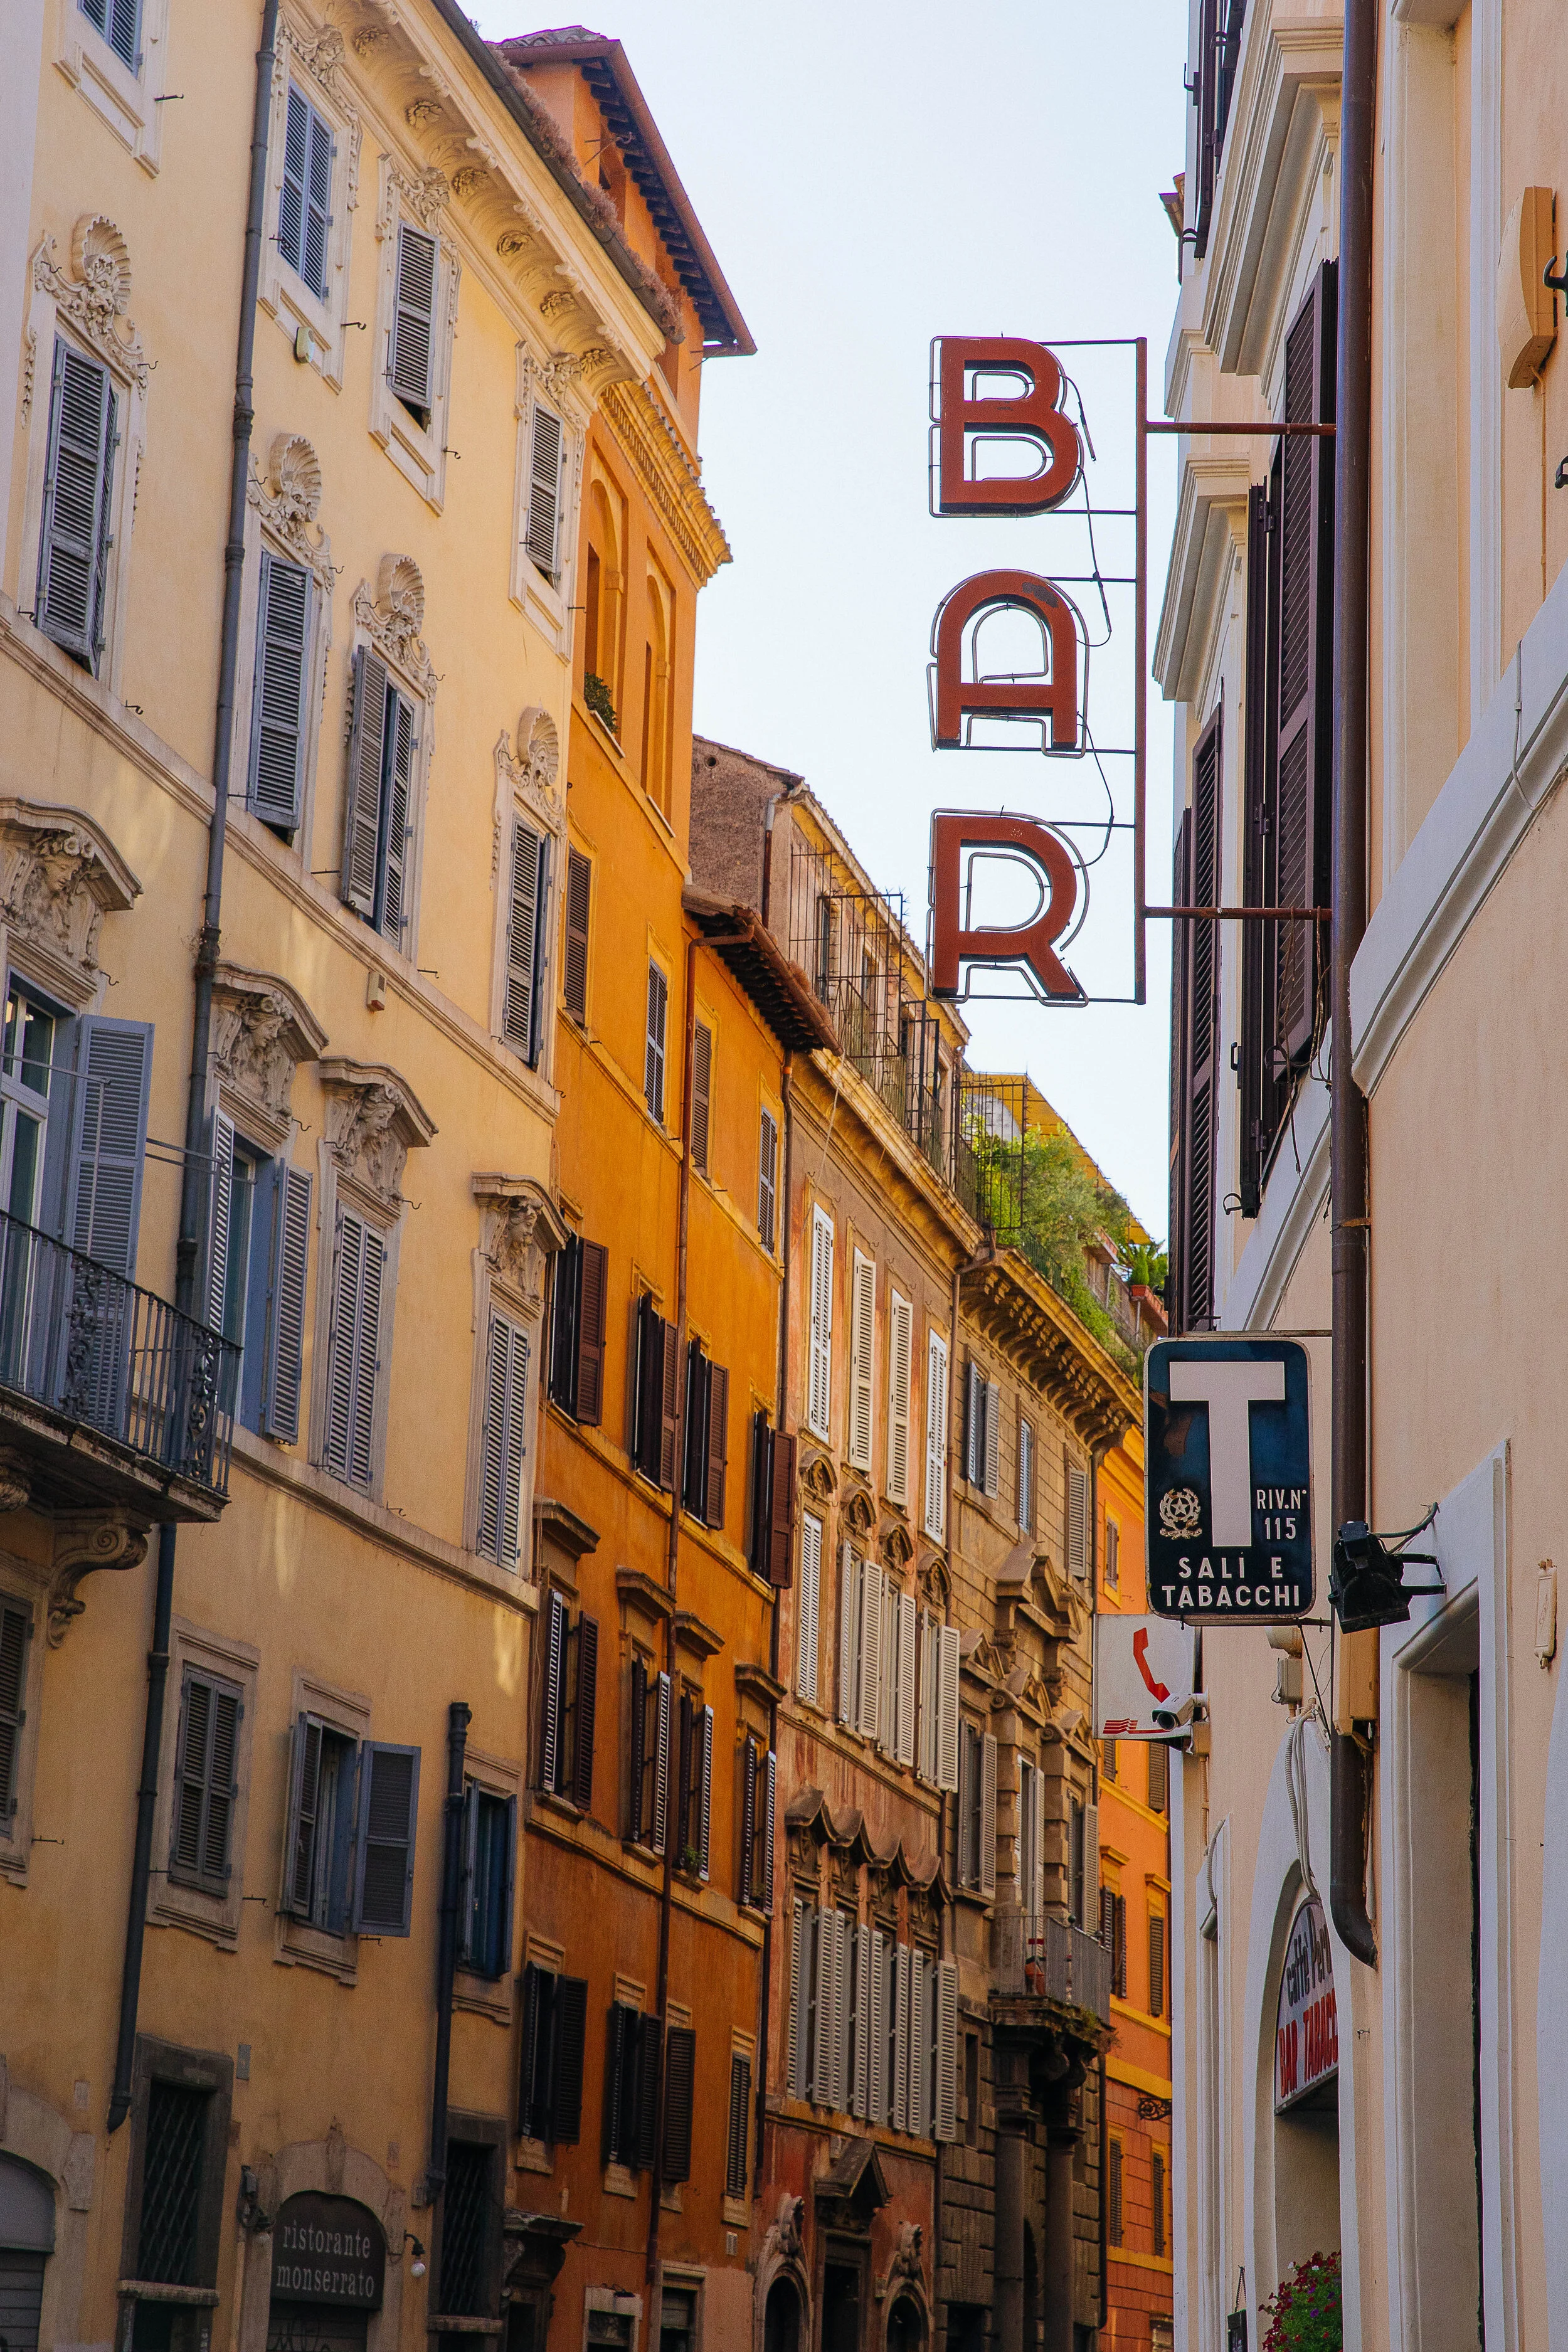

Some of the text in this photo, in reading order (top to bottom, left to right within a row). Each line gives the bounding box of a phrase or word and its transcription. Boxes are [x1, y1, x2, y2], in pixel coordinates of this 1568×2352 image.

[926, 336, 1089, 1008] BAR
[1169, 1361, 1285, 1547] T
[1264, 1517, 1296, 1540] 115
[1179, 1557, 1283, 1579] SALI E
[1162, 1585, 1300, 1607] TABACCHI
[1278, 2019, 1298, 2098] BAR
[282, 2219, 371, 2259] ristorante
[276, 2265, 375, 2298] monserrato
